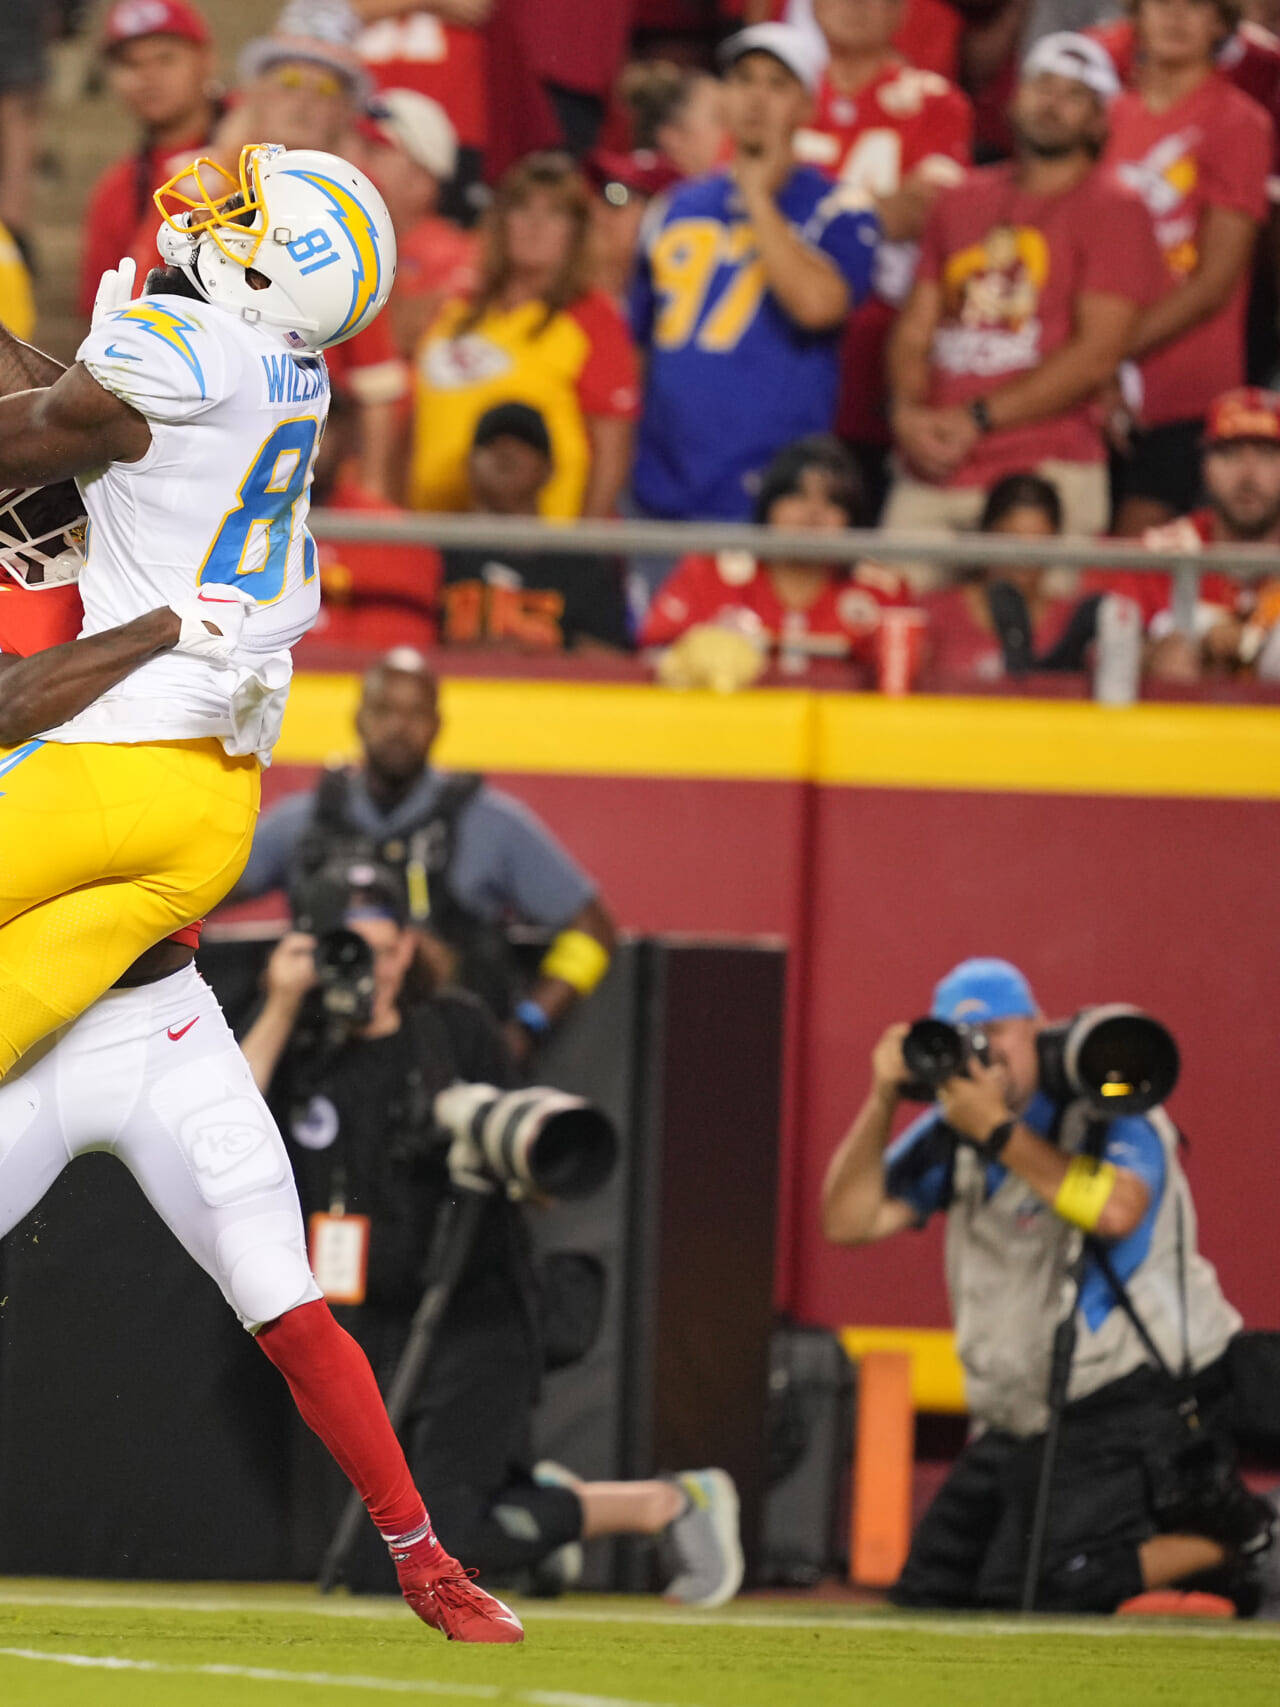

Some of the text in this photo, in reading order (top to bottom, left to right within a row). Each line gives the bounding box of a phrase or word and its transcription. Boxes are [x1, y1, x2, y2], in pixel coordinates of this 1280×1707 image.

[285, 228, 341, 276] 81
[650, 217, 766, 352] 97
[196, 415, 328, 605] 8
